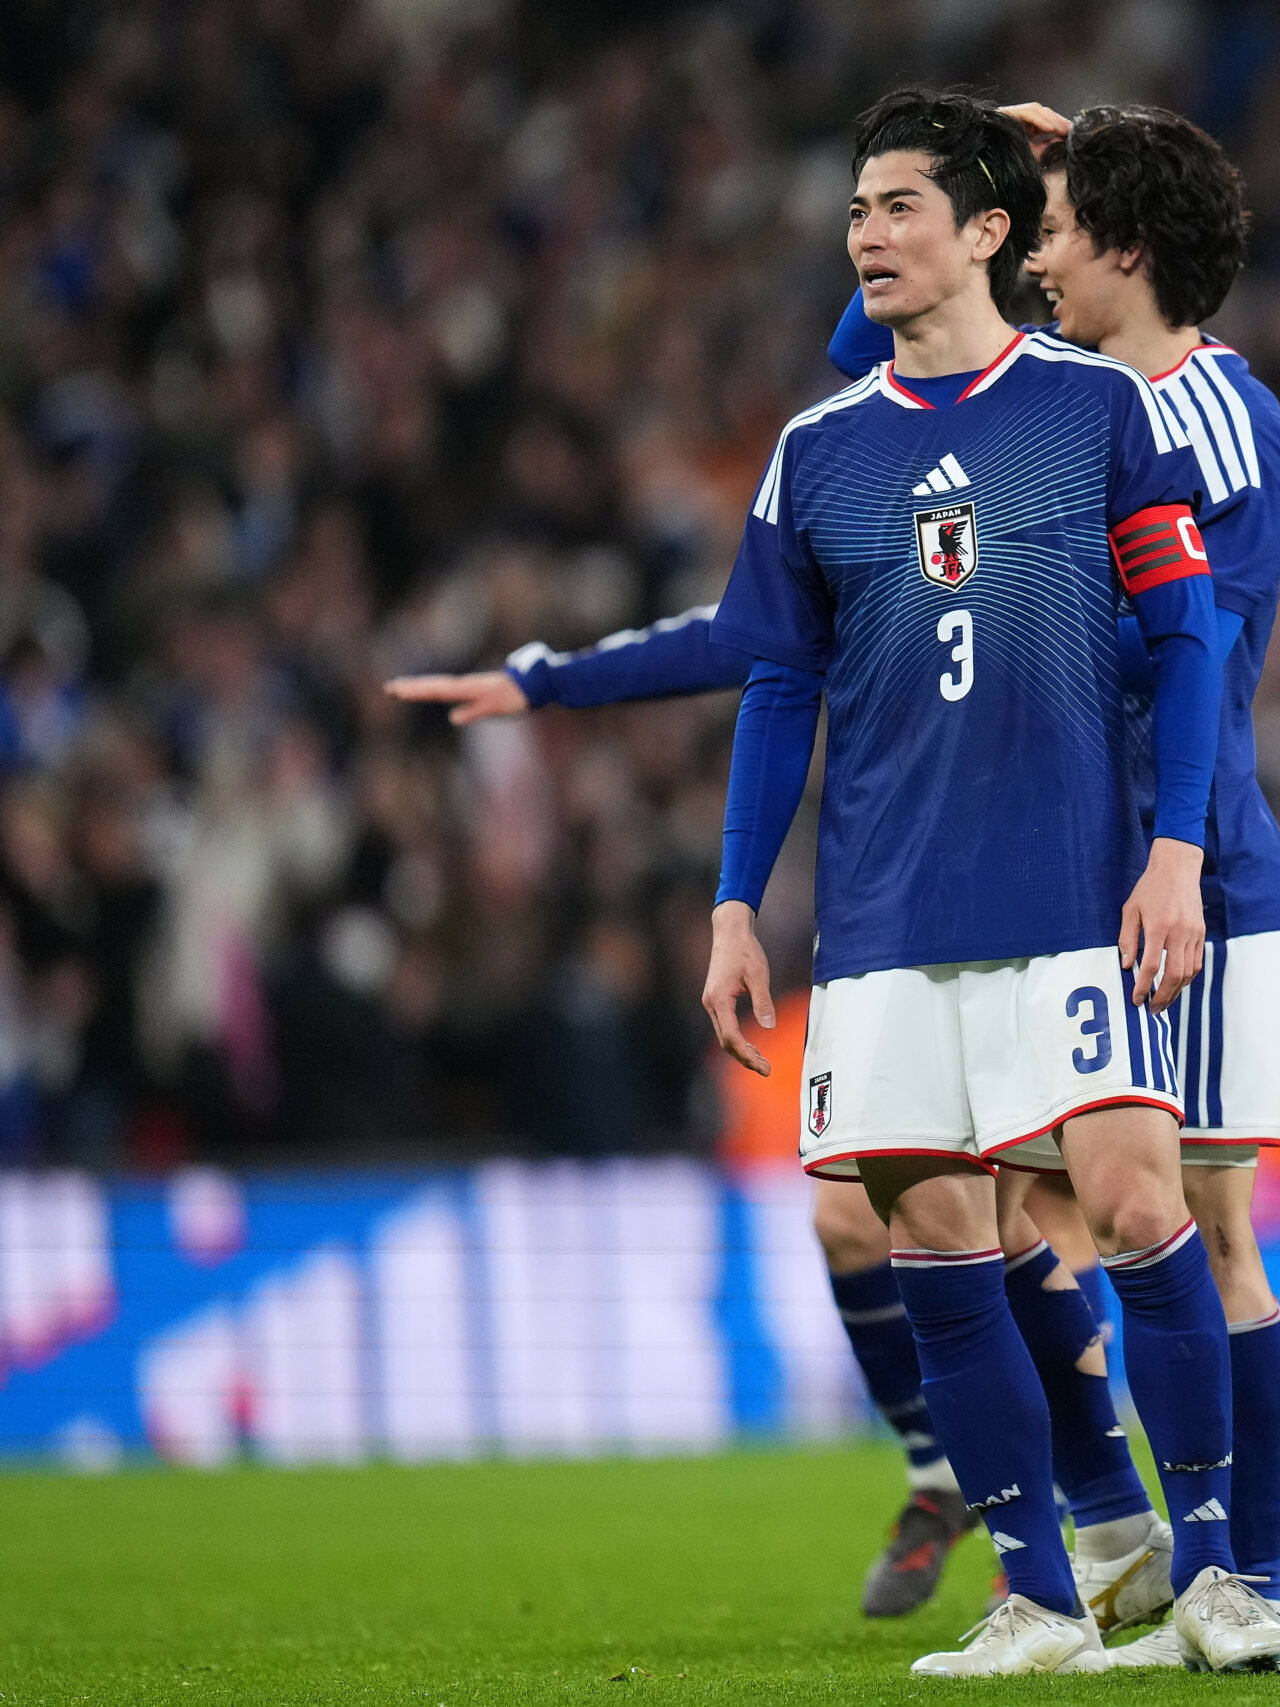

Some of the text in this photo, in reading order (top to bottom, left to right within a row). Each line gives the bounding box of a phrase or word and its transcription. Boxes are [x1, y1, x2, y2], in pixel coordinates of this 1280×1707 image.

[930, 508, 961, 520] JAPAN
[939, 561, 965, 577] JFA
[937, 610, 974, 701] 3
[1066, 986, 1112, 1075] 3
